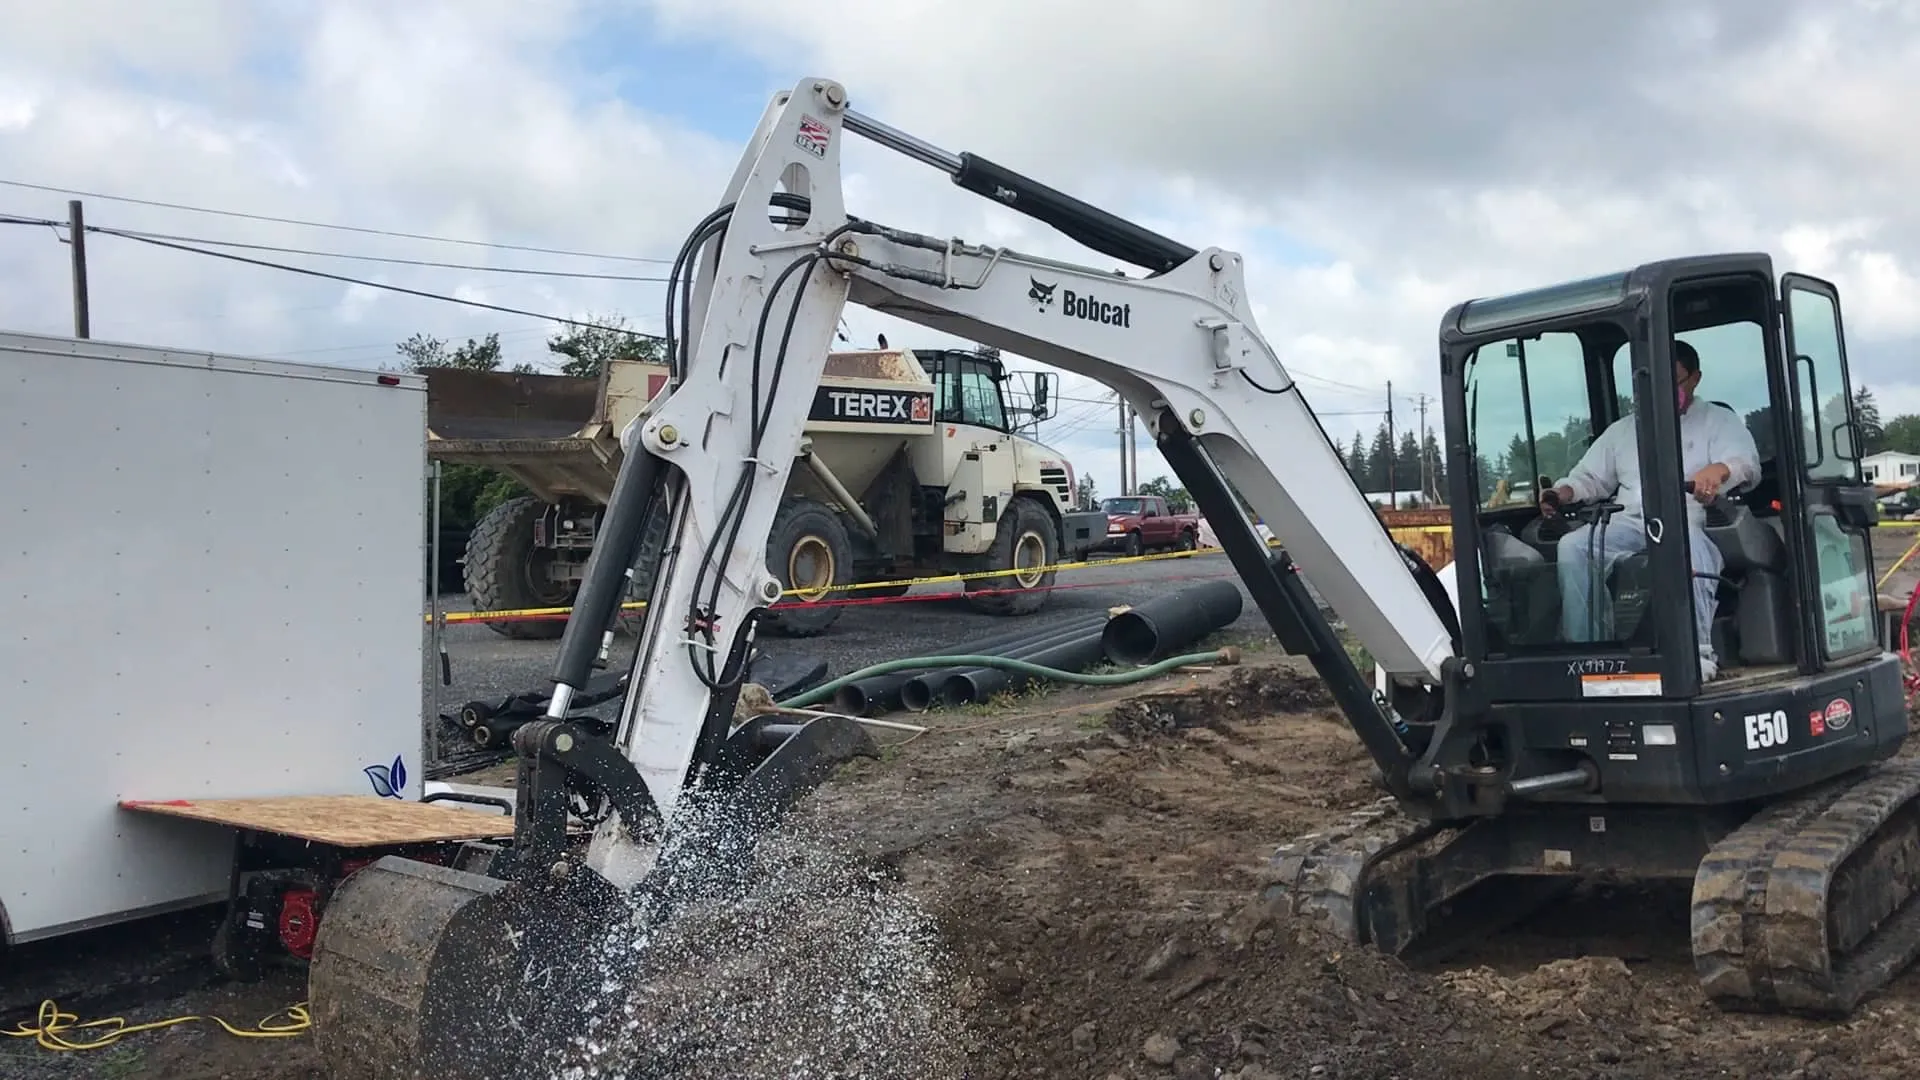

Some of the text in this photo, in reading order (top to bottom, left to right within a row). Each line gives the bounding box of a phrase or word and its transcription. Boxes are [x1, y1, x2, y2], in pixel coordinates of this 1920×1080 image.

[797, 134, 824, 157] USA
[1063, 289, 1130, 328] Bobcat
[829, 392, 907, 418] TEREX
[1744, 709, 1789, 750] E50
